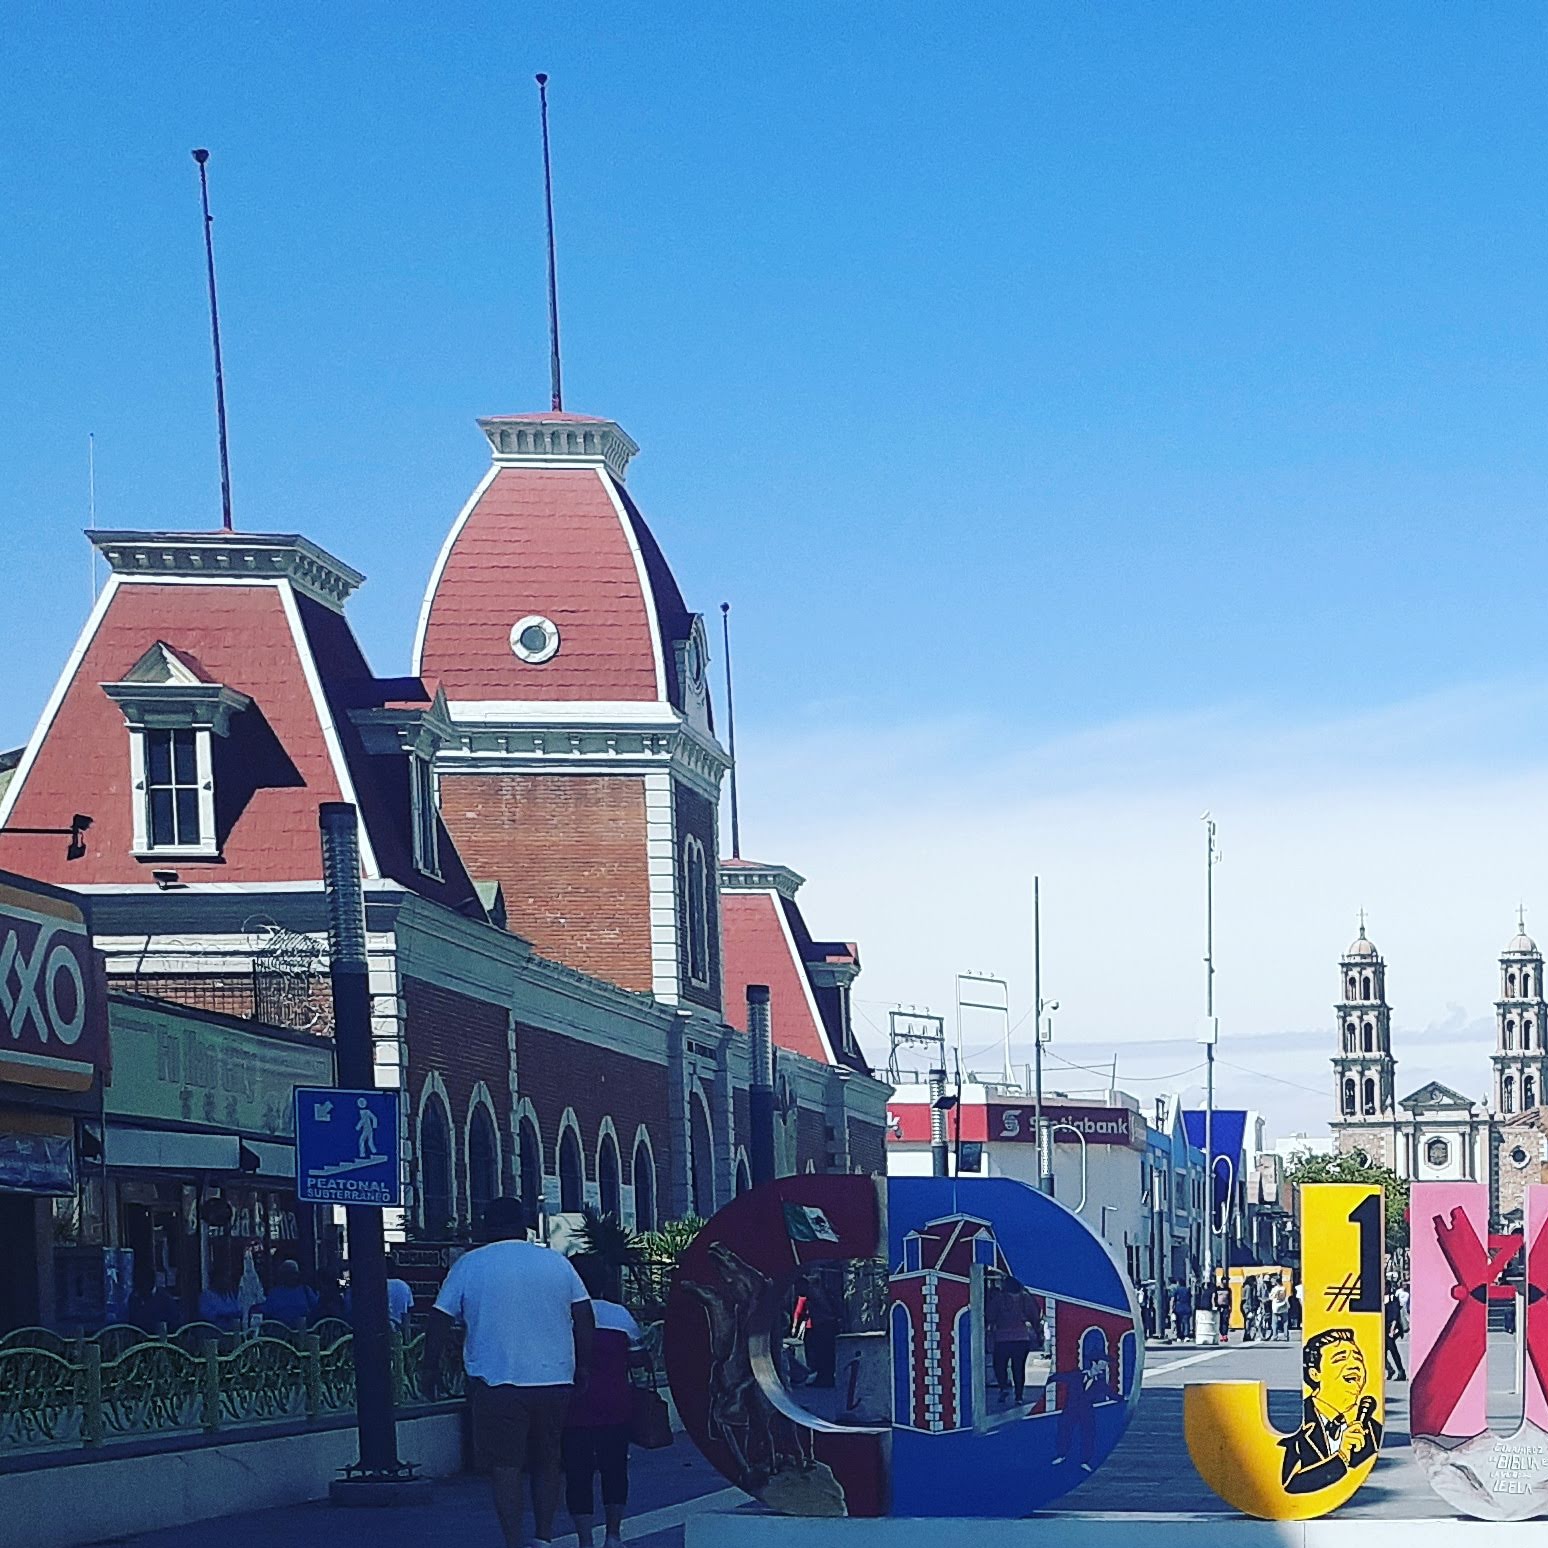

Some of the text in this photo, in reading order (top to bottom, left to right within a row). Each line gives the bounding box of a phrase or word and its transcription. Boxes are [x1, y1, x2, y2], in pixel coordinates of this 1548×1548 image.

[1029, 1115, 1128, 1134] Stiabank
[307, 1177, 390, 1192] PEATONAL
[307, 1188, 391, 1202] SUBTERRANEO
[1496, 1453, 1539, 1470] BIBLIA
